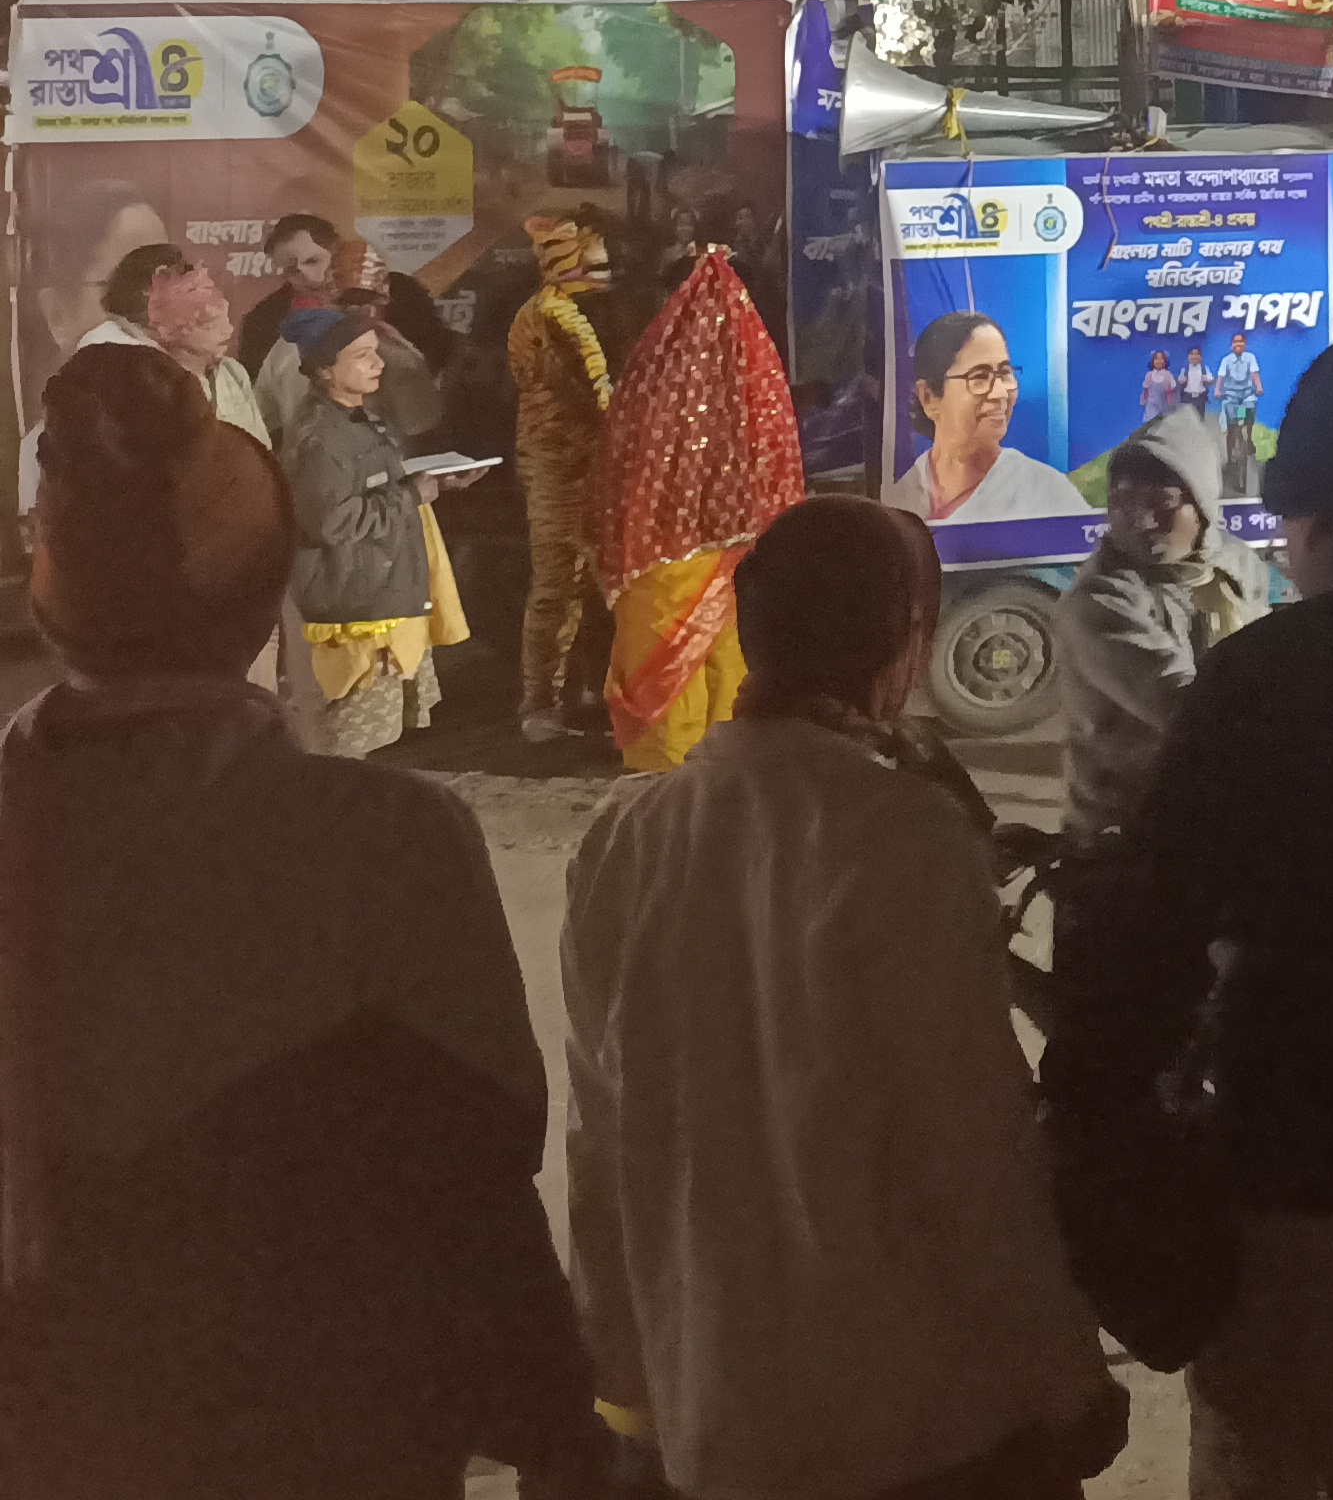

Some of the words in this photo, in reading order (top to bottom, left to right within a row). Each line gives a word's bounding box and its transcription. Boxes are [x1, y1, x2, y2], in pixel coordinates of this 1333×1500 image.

[385, 117, 441, 168] ২০
[1142, 170, 1182, 187] মমতা
[185, 219, 266, 246] বাংলার
[1111, 243, 1159, 260] বাংলার
[1161, 237, 1193, 258] মাটি
[1198, 241, 1255, 258] বাংলার
[1257, 239, 1285, 255] পথ
[1071, 295, 1214, 341] বাংলার
[1221, 290, 1325, 331] শপথ
